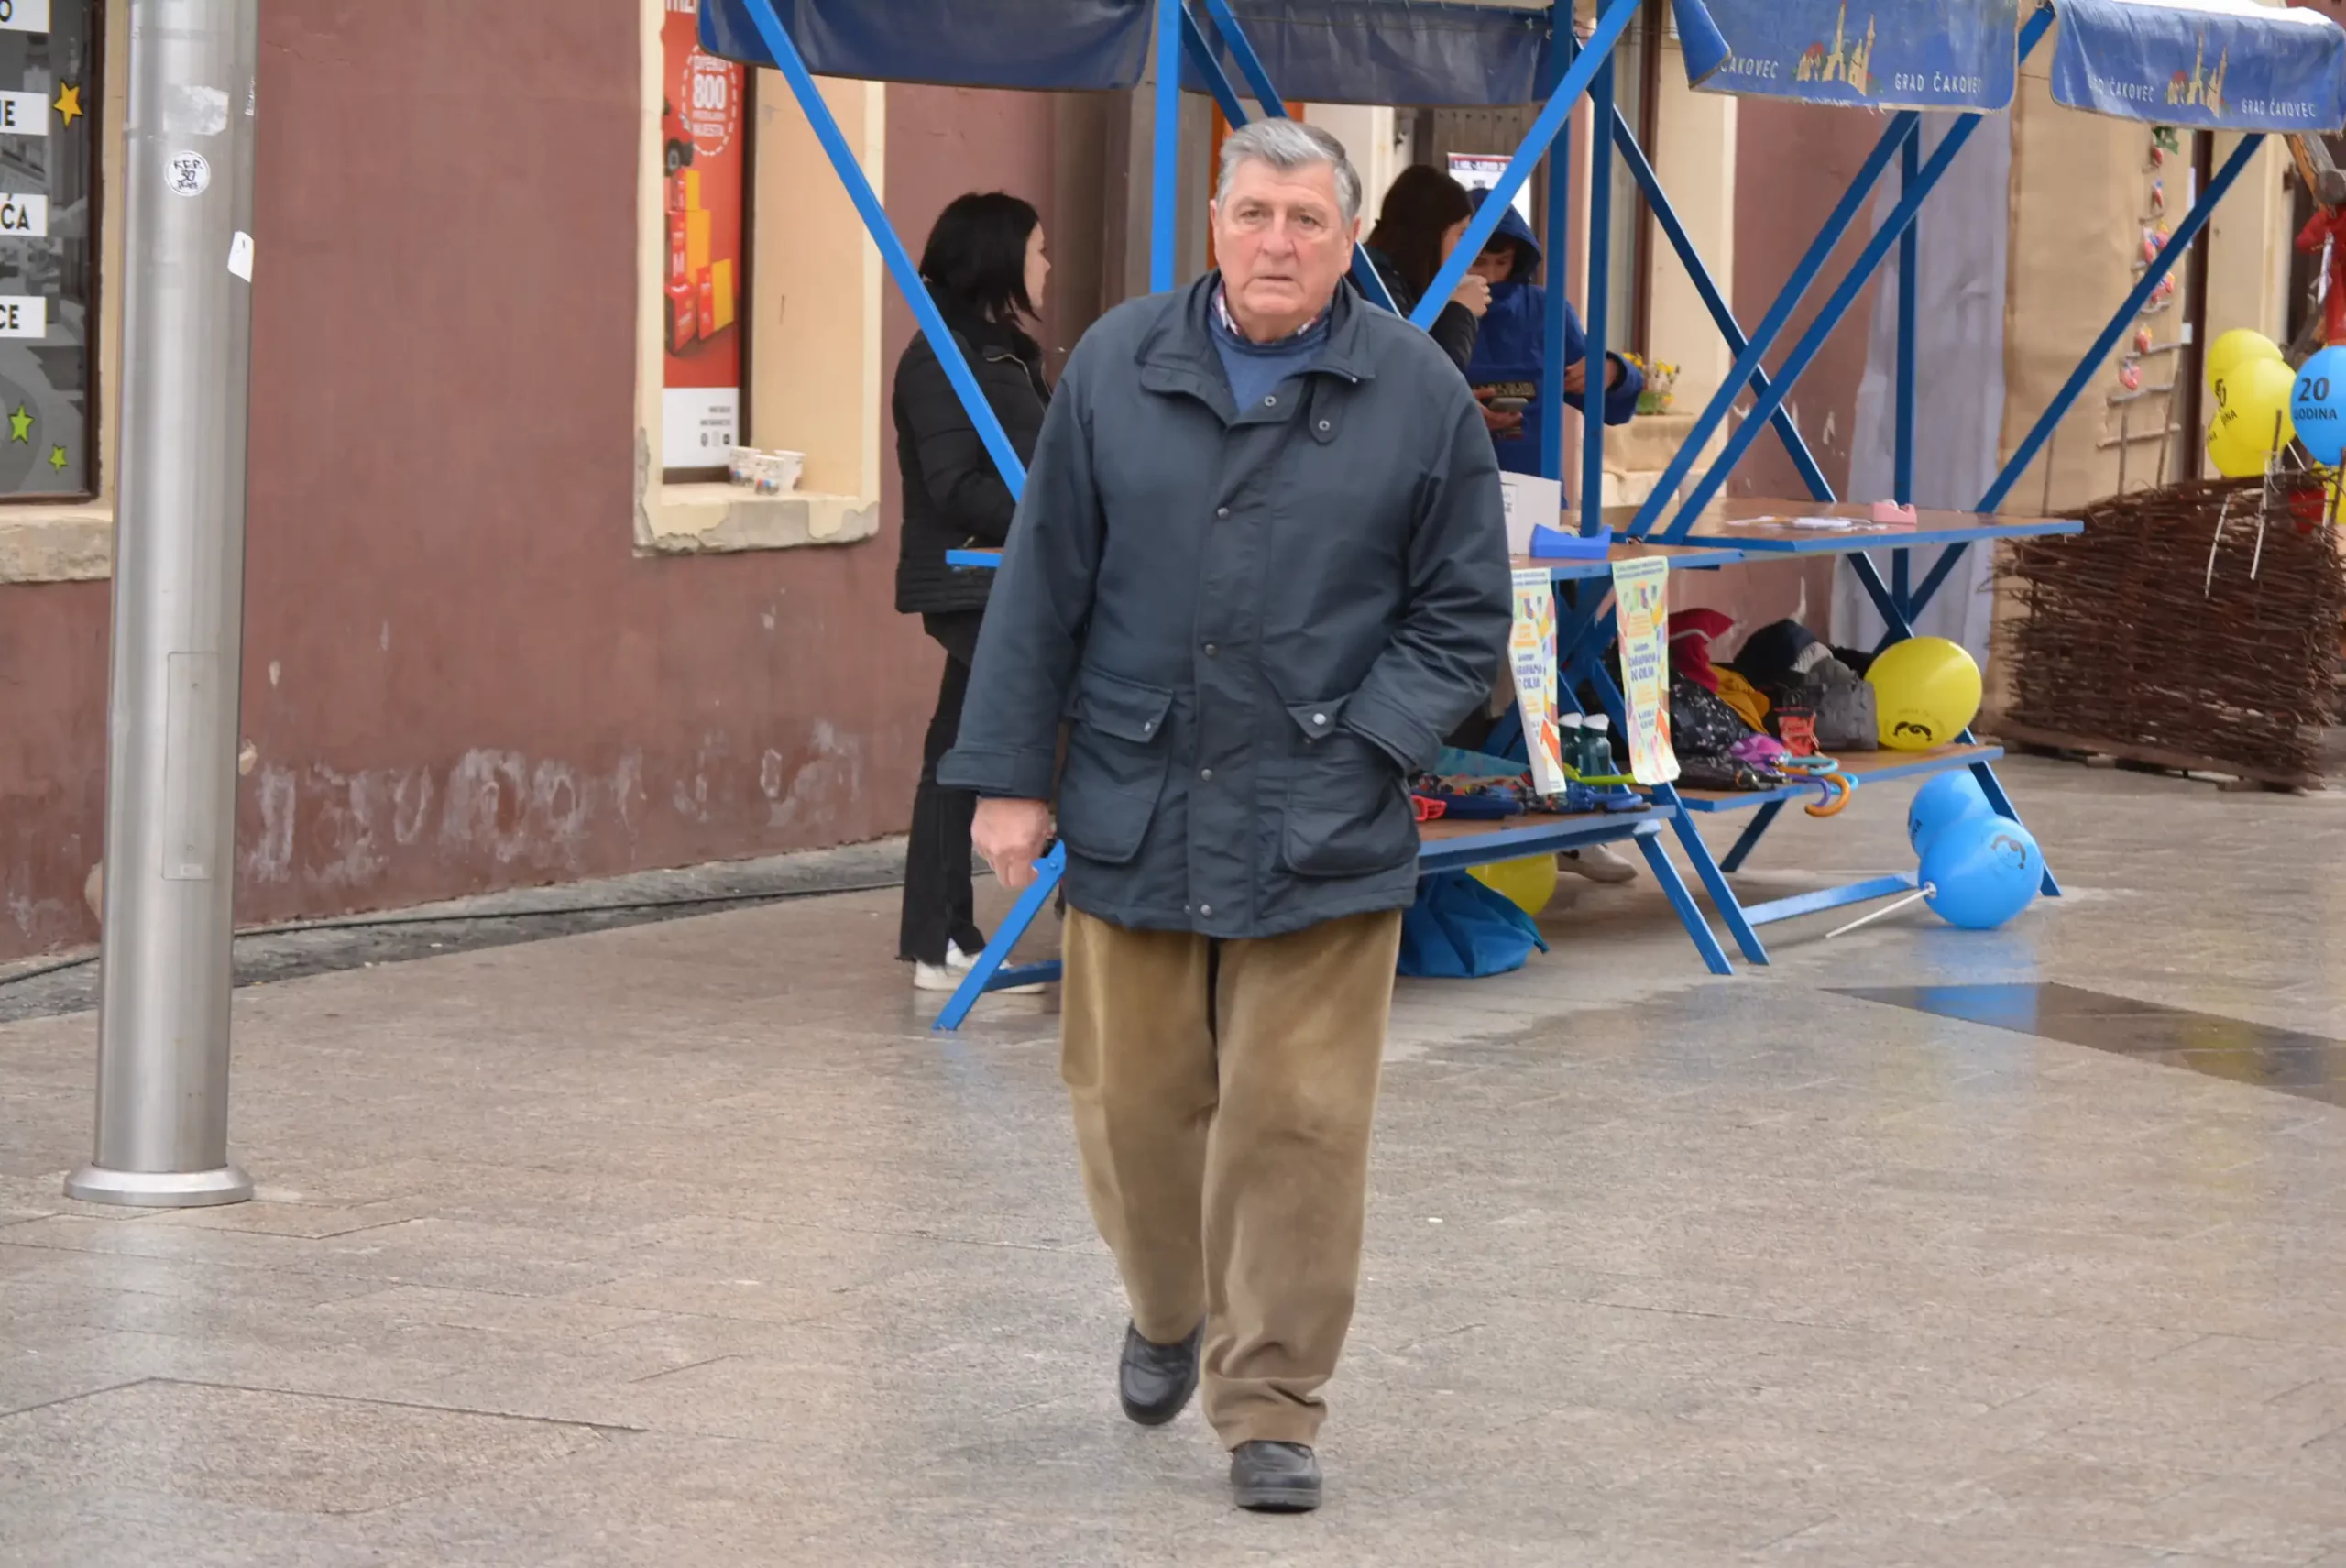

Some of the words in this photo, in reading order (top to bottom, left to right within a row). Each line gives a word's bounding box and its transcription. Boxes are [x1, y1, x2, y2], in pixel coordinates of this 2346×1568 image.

[693, 73, 727, 109] 800
[1894, 72, 1924, 92] GRAD
[2110, 76, 2155, 103] ČAKOVEC
[2242, 98, 2265, 115] GRAD
[2270, 98, 2317, 117] ČAKOVEC
[2298, 377, 2330, 402] 20
